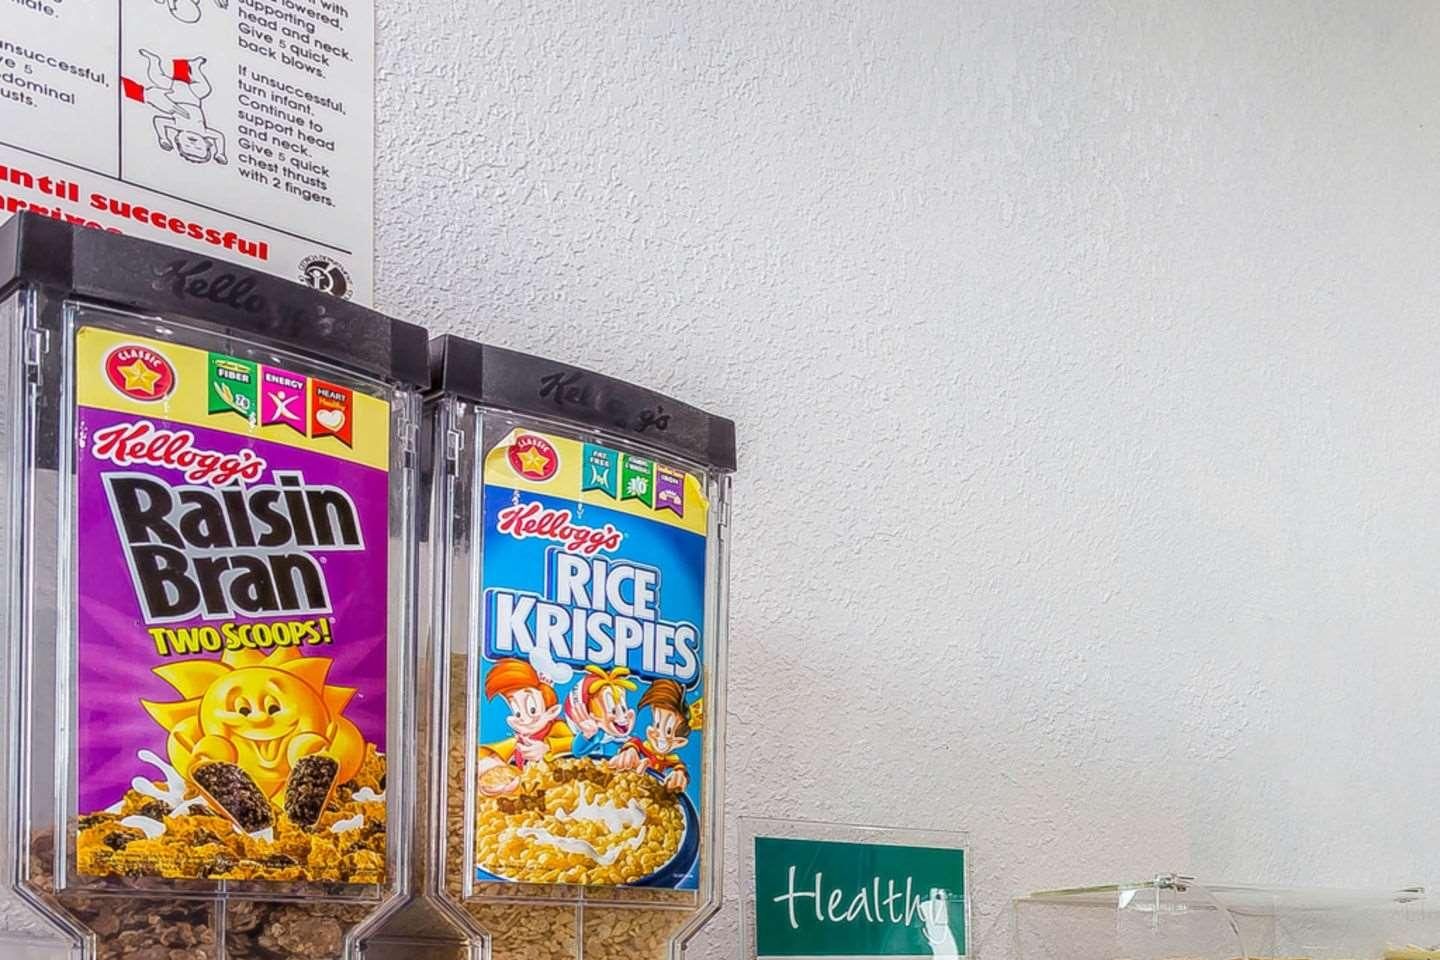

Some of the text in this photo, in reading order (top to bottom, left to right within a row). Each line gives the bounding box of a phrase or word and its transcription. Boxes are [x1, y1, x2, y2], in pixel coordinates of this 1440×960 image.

[238, 7, 353, 62] head and neck.
[240, 0, 316, 34] upporting
[238, 22, 329, 67] Give 5 quick
[238, 36, 276, 60] back
[0, 72, 75, 104] dominal
[238, 64, 247, 76] If
[238, 79, 267, 98] turn
[238, 94, 324, 133] Continue to
[238, 110, 335, 152] support head
[238, 125, 268, 142] and
[238, 137, 330, 178] Give 5 quick
[238, 153, 328, 191] chest thrusts
[238, 167, 269, 185] with
[272, 177, 282, 189] 2
[90, 193, 269, 261] successful
[117, 349, 162, 368] CLASSIC
[218, 368, 250, 383] FIBER
[265, 373, 304, 390] ENERGY
[317, 388, 347, 402] HEART
[97, 422, 264, 485] Kellogg's
[517, 438, 551, 453] CLASSIC
[105, 472, 363, 551] Raisin
[499, 503, 622, 556] Kellogg's
[131, 546, 330, 621] Bran
[555, 551, 658, 621] RICE
[149, 617, 332, 656] TWO SCOOPS!
[493, 590, 698, 681] KRISPIES
